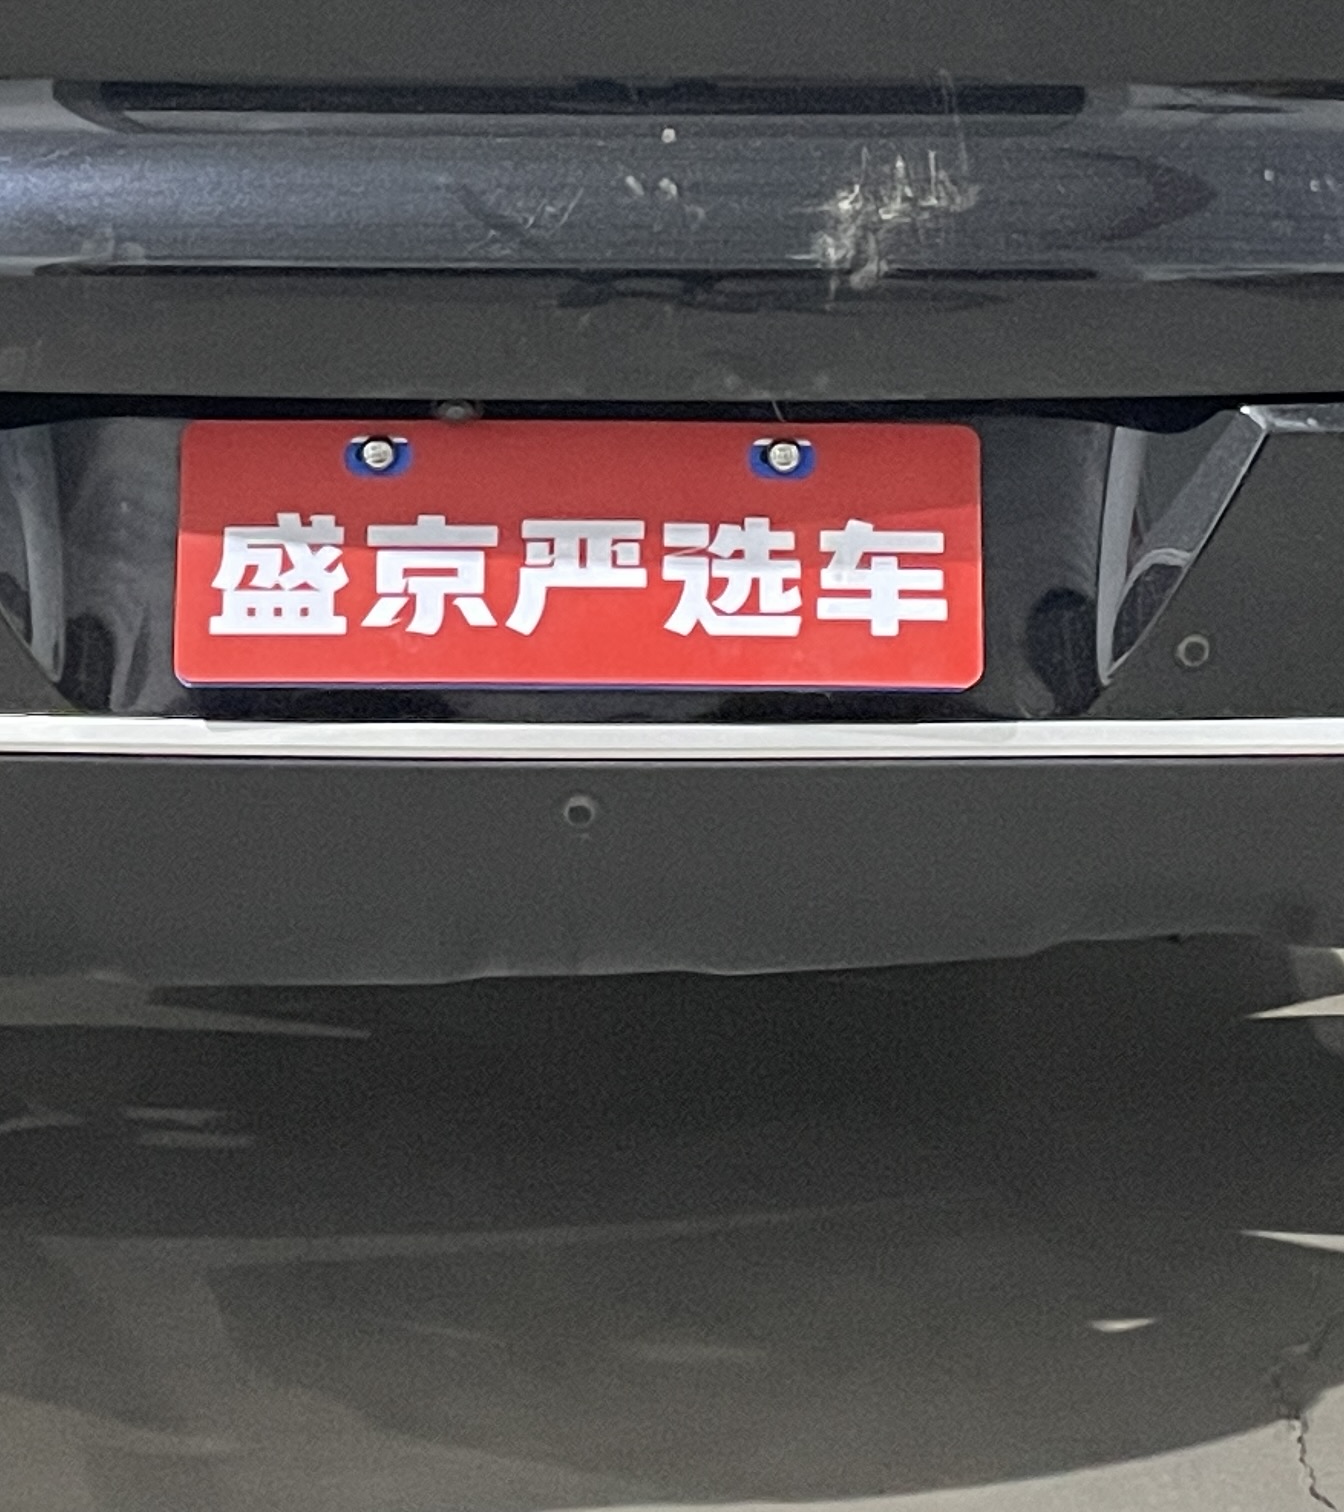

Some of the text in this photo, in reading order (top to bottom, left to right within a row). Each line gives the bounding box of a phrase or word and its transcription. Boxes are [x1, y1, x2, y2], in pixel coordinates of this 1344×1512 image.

[209, 513, 949, 637] 盛京严选车
